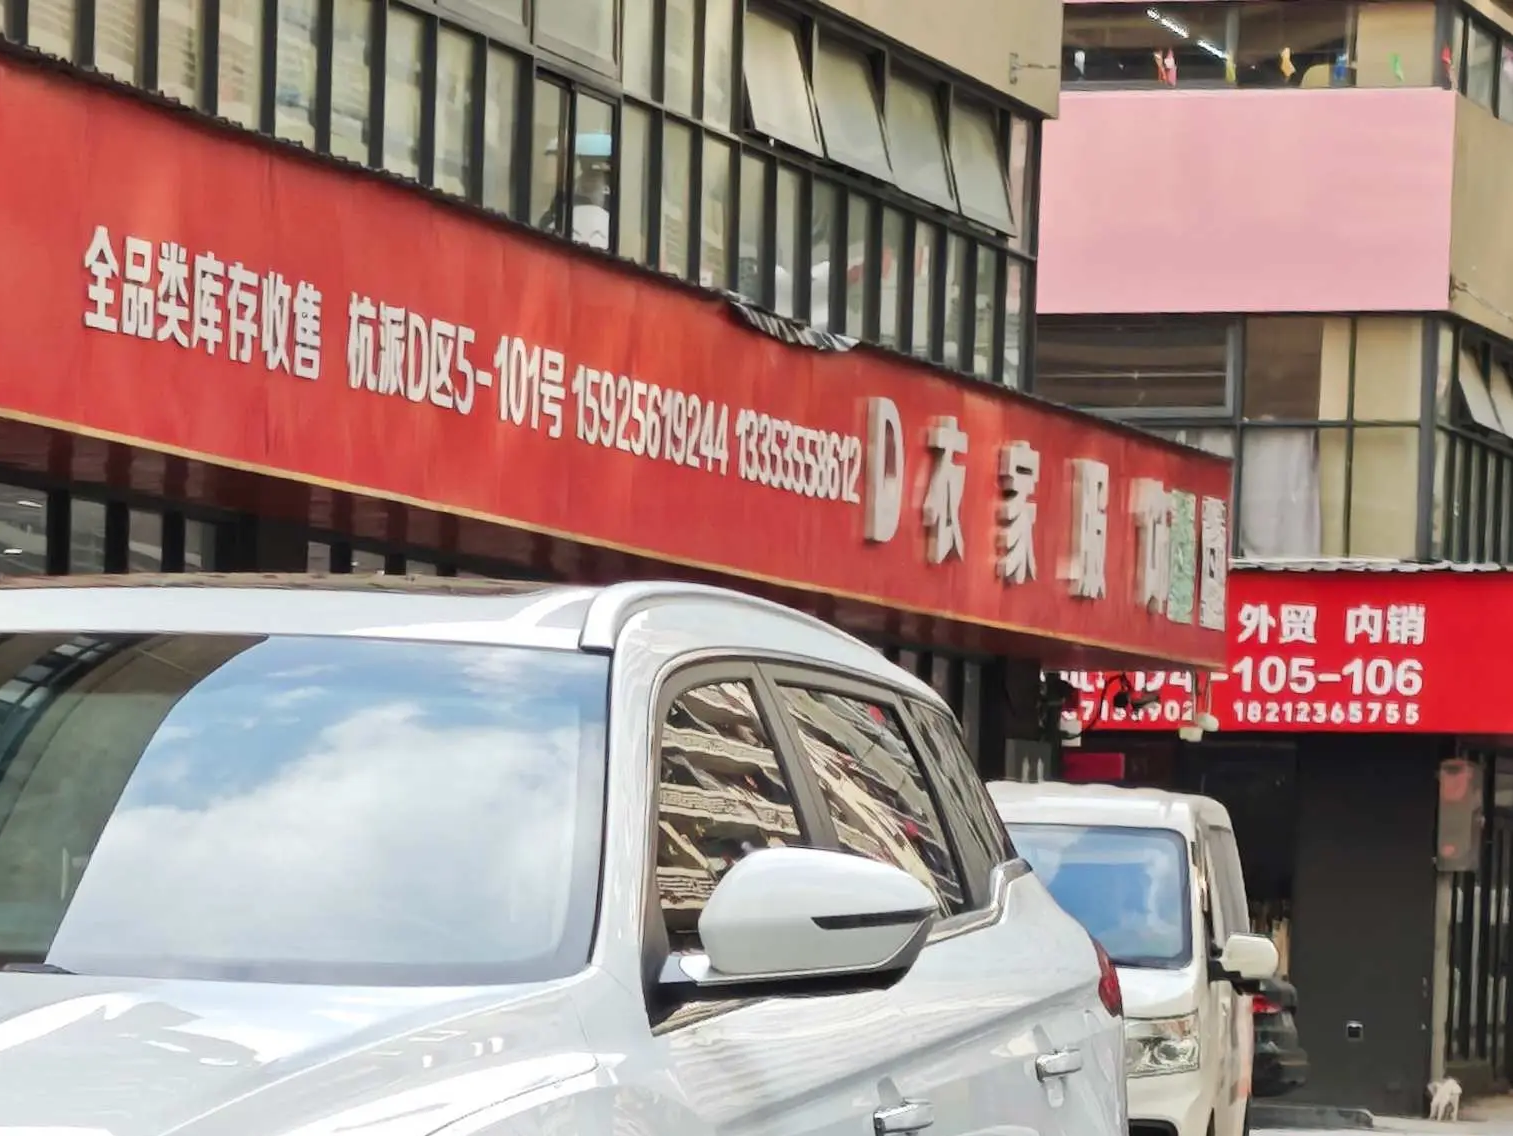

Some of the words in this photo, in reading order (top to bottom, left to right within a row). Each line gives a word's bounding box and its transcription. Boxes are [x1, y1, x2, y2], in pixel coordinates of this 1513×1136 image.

[84, 225, 322, 380] 全品类库存收售
[572, 363, 729, 476] 15925619244
[1238, 603, 1317, 644] 外贸
[1345, 604, 1425, 645] 内销
[1233, 700, 1419, 725] 18212365755
